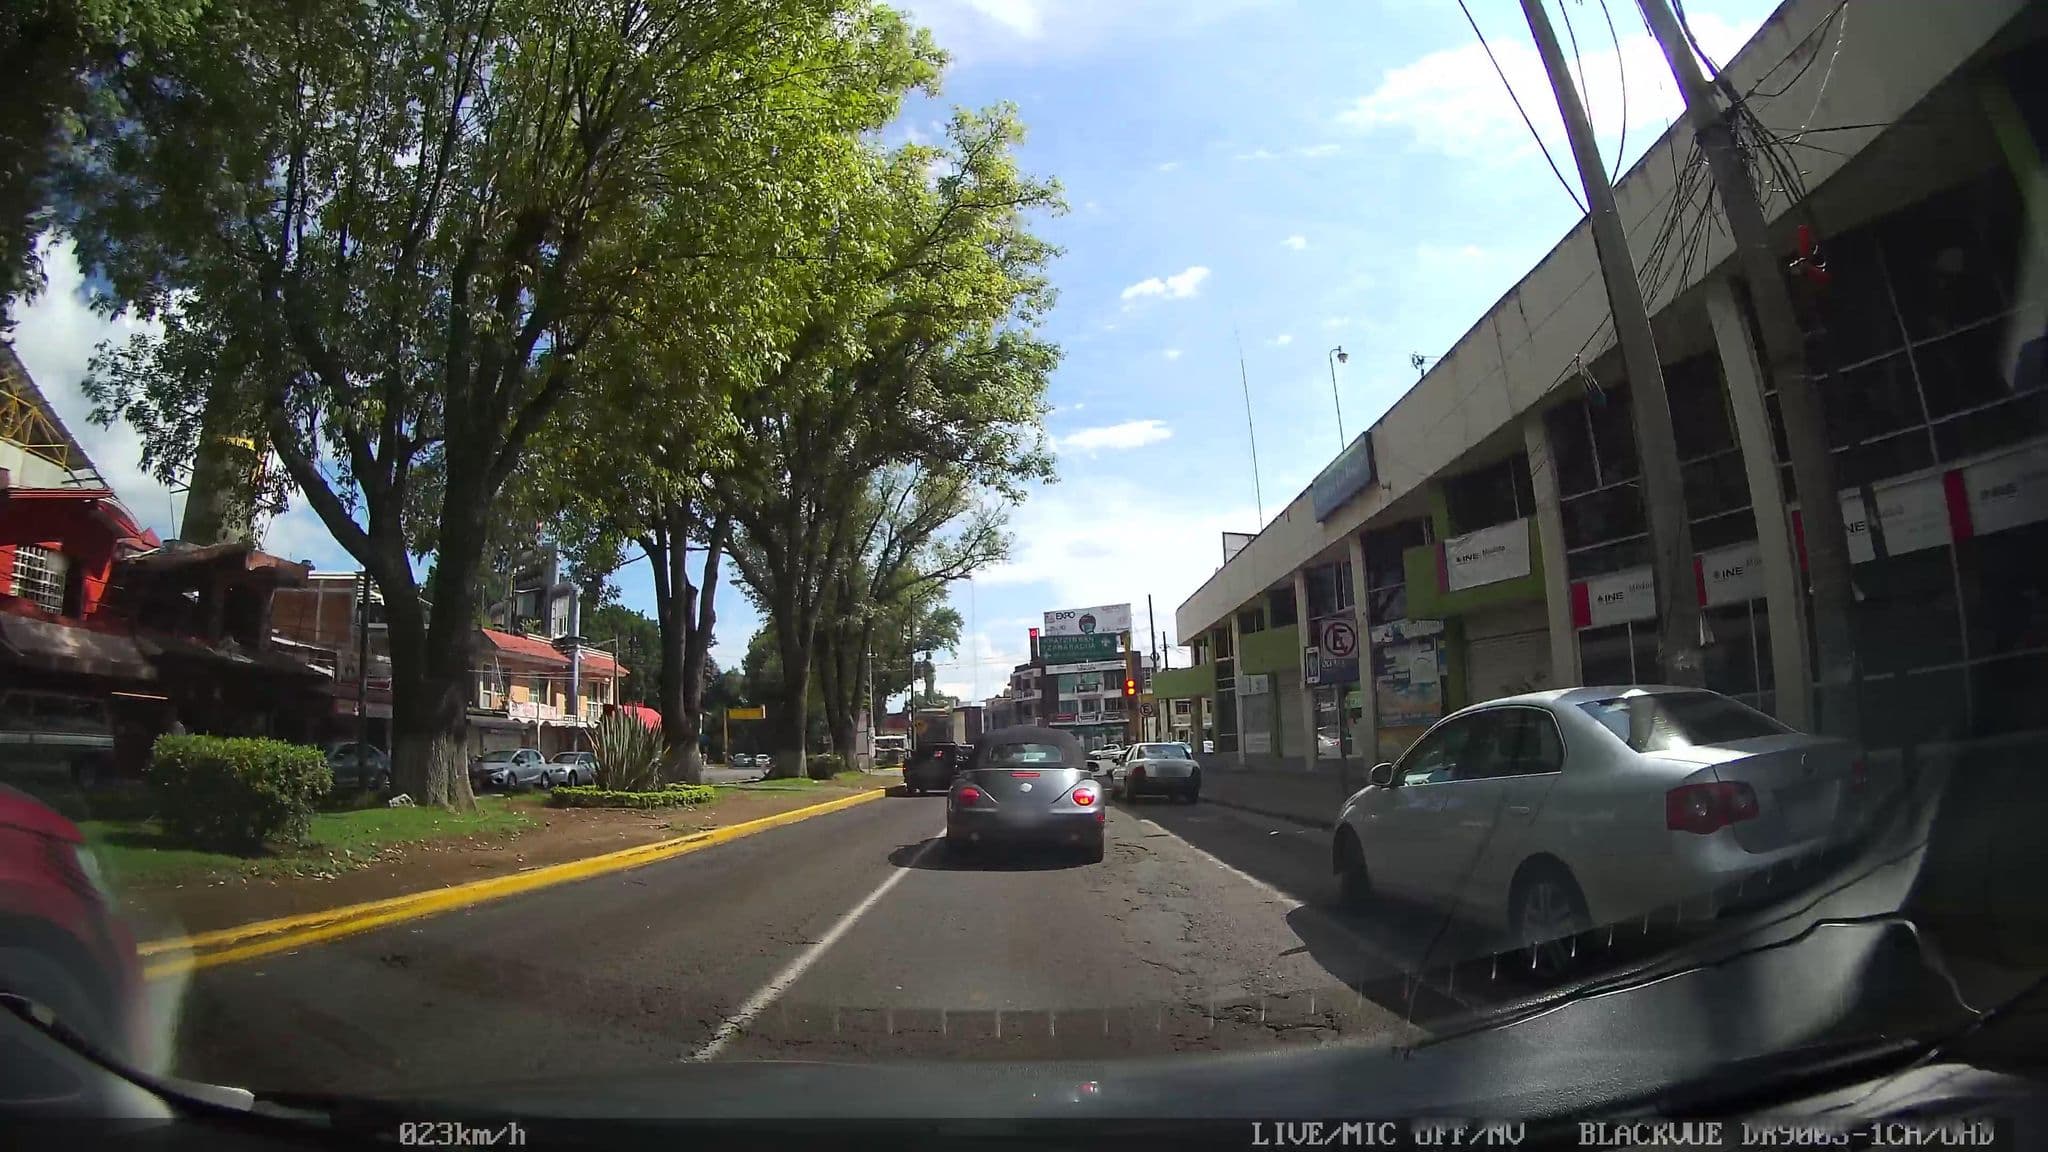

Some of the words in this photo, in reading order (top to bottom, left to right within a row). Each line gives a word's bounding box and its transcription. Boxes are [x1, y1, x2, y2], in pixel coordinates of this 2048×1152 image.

[1846, 521, 1865, 532] NE
[1463, 552, 1480, 561] INE
[1722, 566, 1744, 578] INE
[1605, 592, 1624, 604] INE
[1055, 611, 1076, 620] EXPO
